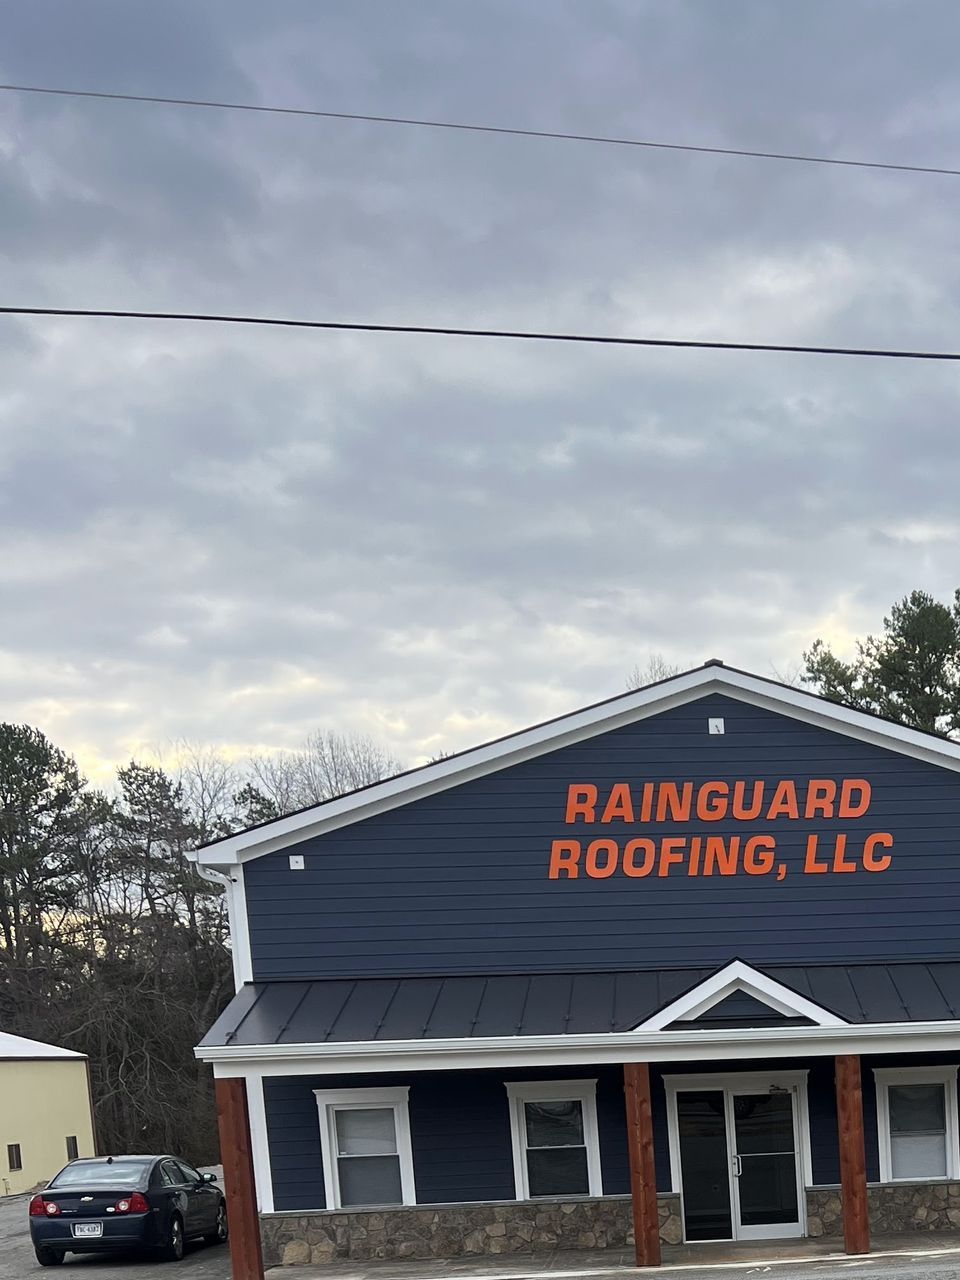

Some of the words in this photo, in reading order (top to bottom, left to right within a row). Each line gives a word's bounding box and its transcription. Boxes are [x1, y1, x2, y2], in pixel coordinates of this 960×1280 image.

[565, 779, 872, 824] RAINGUARD
[548, 835, 787, 881] ROOFING,
[804, 832, 893, 874] LLC
